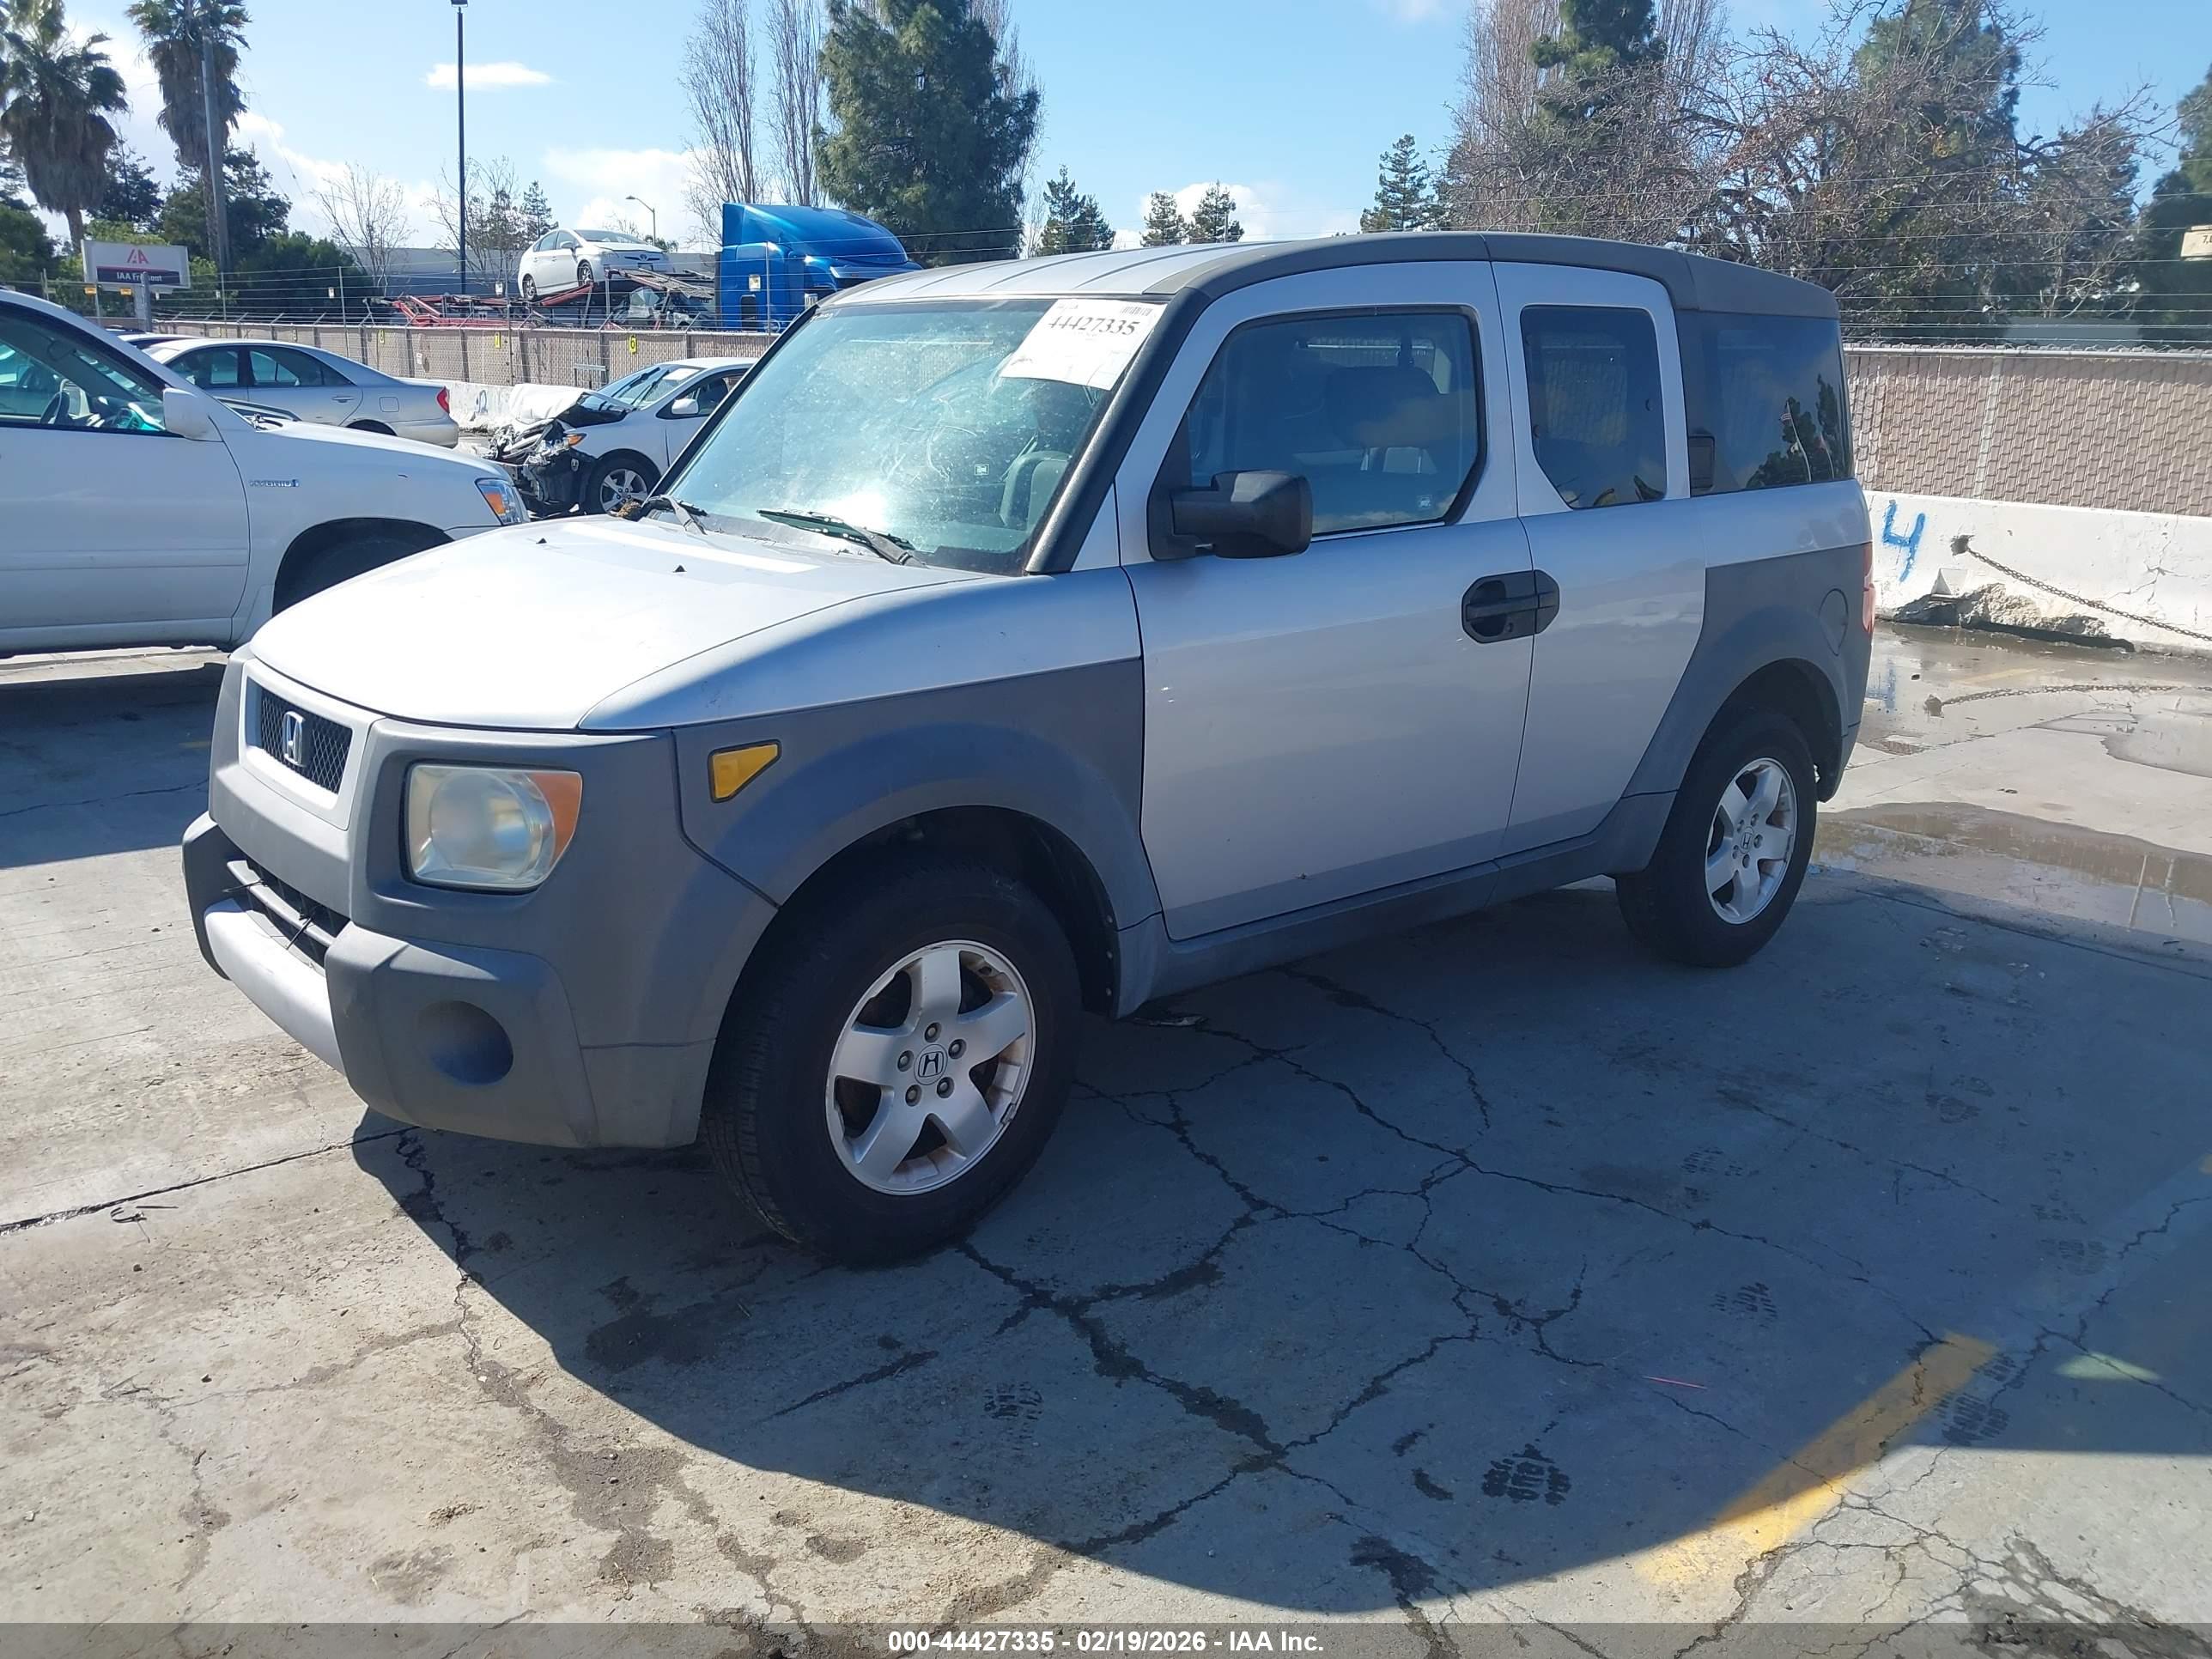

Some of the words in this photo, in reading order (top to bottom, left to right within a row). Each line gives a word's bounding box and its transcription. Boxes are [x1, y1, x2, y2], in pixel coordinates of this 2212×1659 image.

[116, 271, 131, 280] IAA
[1048, 315, 1141, 336] 44427335
[1881, 499, 1926, 582] 4
